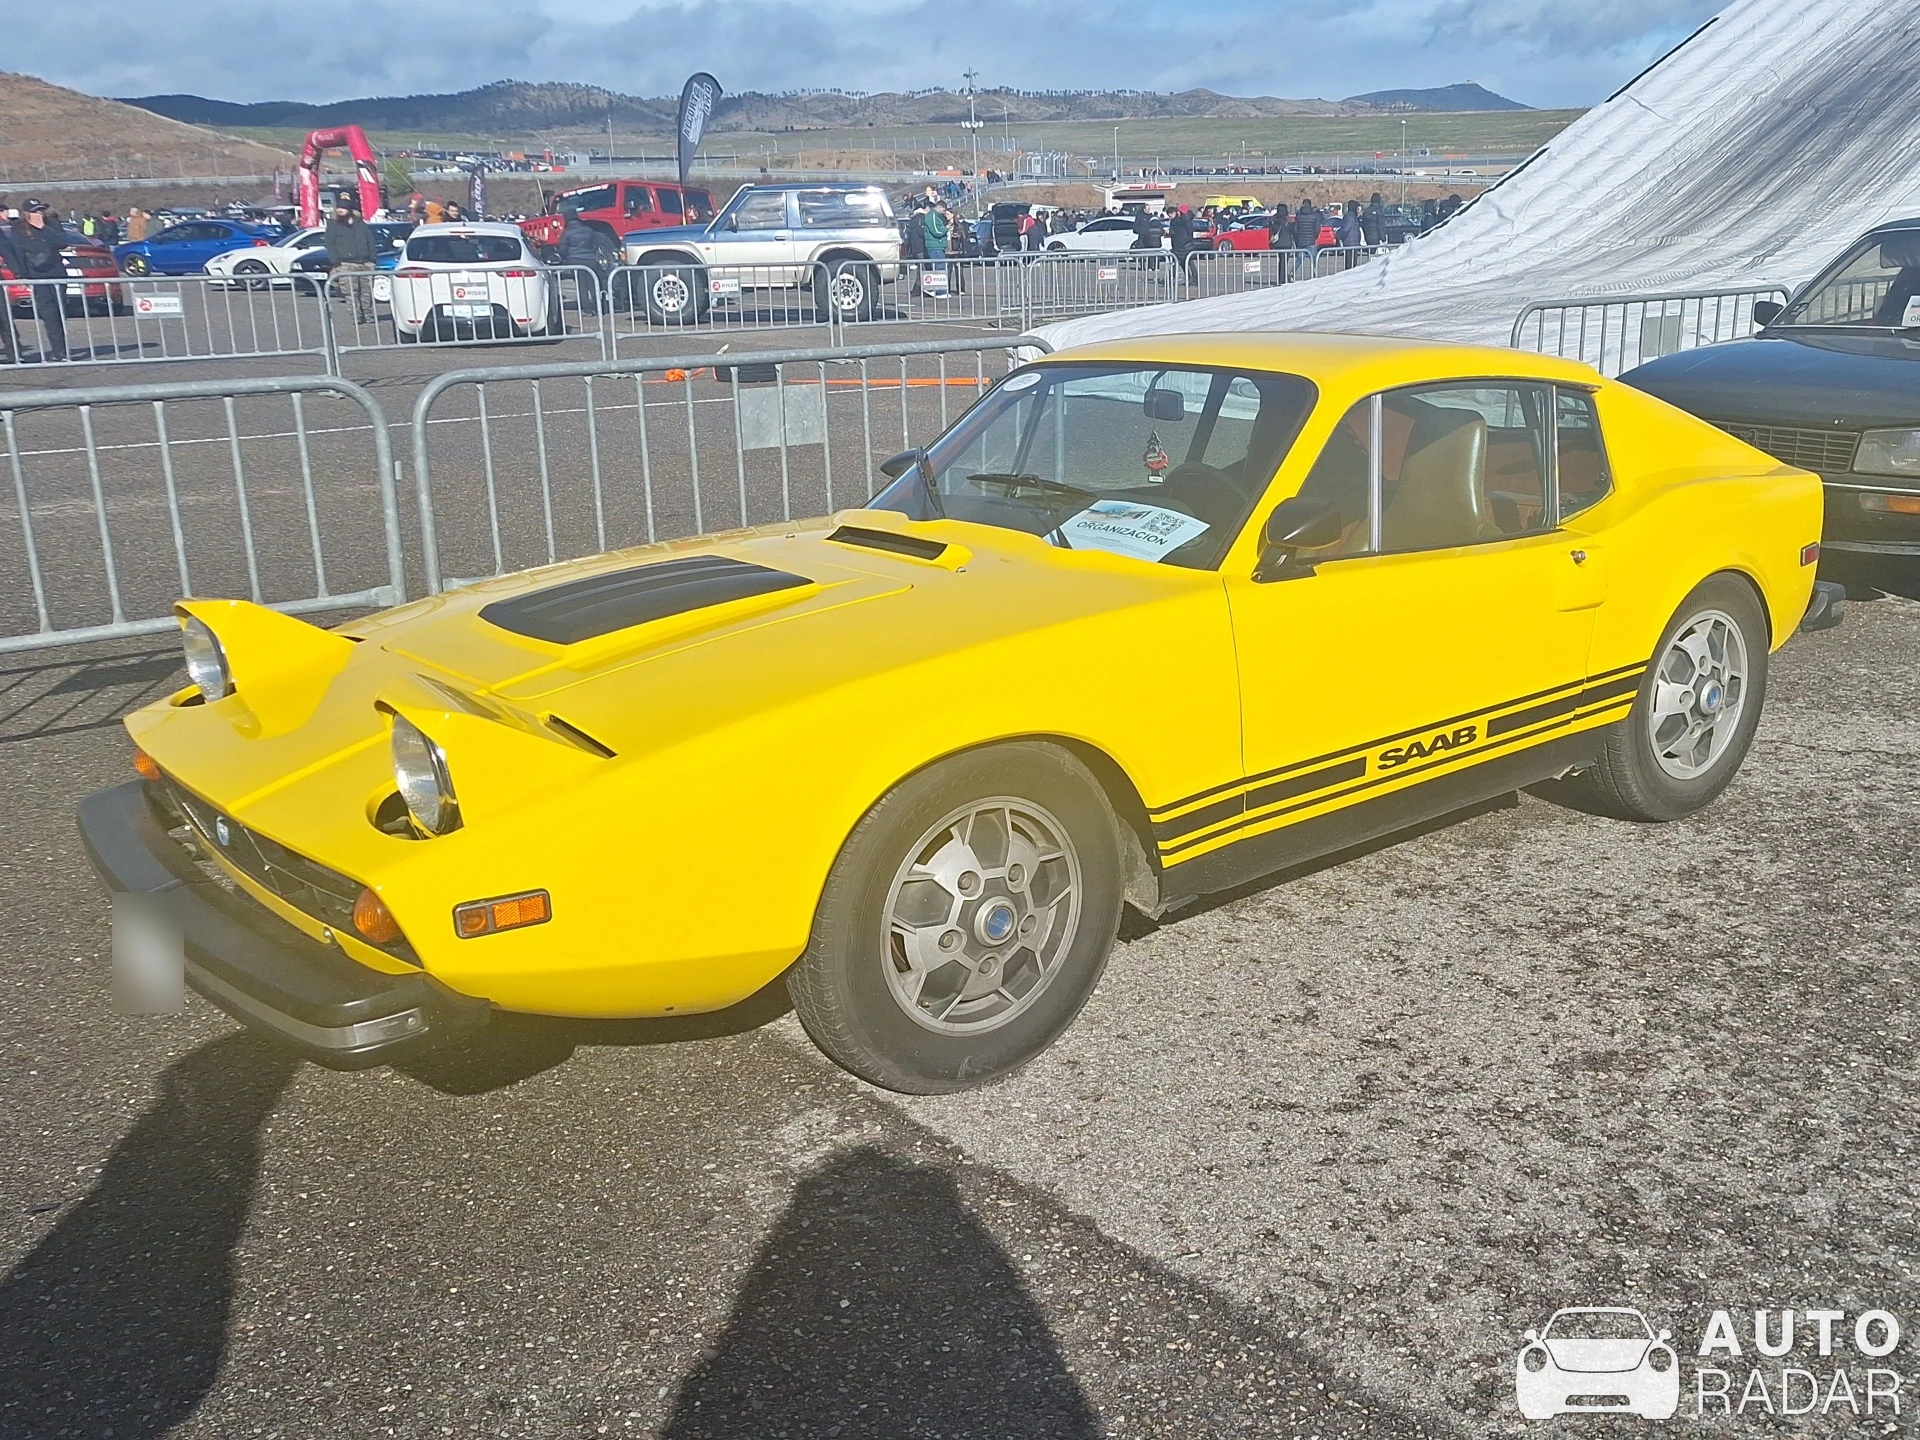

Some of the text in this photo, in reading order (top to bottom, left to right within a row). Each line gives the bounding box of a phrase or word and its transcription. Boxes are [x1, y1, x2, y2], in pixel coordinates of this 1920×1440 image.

[682, 83, 702, 138] ALCORTE
[1076, 521, 1169, 546] ORGANIZACION
[1377, 725, 1477, 770] SAAB
